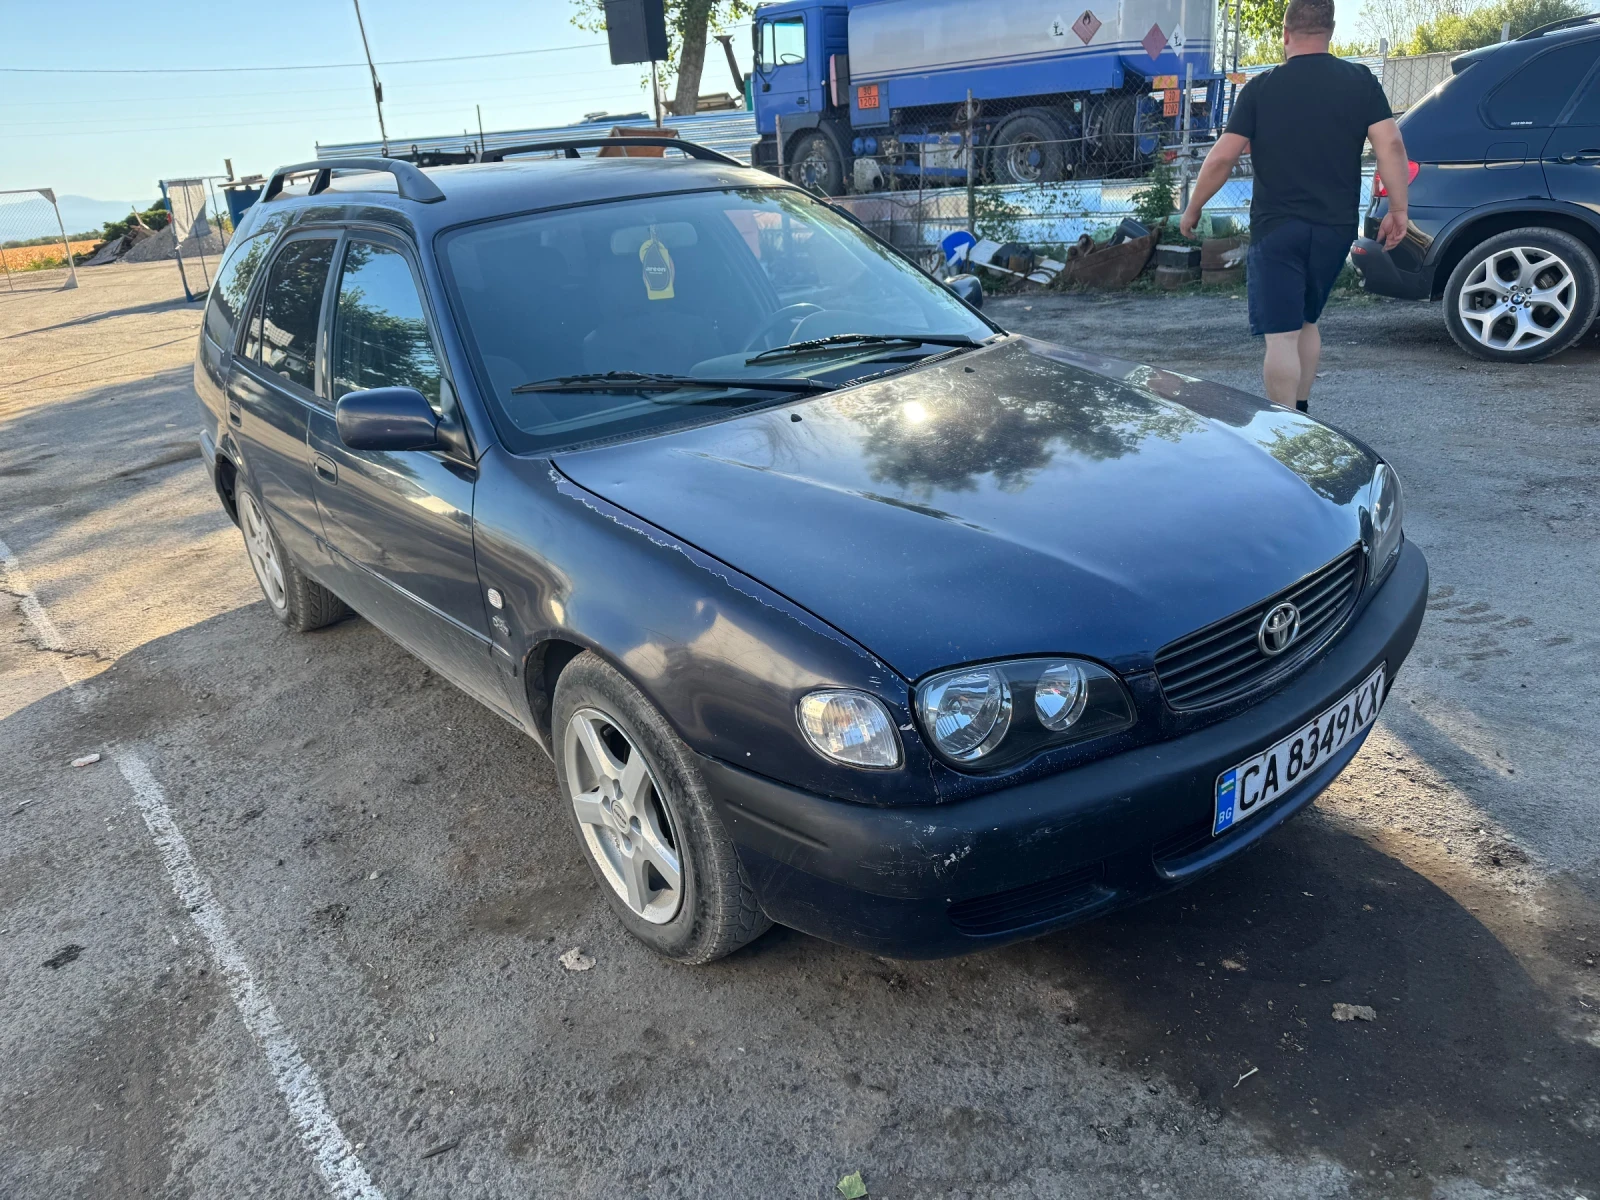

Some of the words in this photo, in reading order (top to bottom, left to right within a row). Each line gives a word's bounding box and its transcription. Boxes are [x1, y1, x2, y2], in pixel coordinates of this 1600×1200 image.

[864, 86, 872, 96] 30
[860, 97, 877, 107] 1202
[1218, 806, 1232, 825] BG
